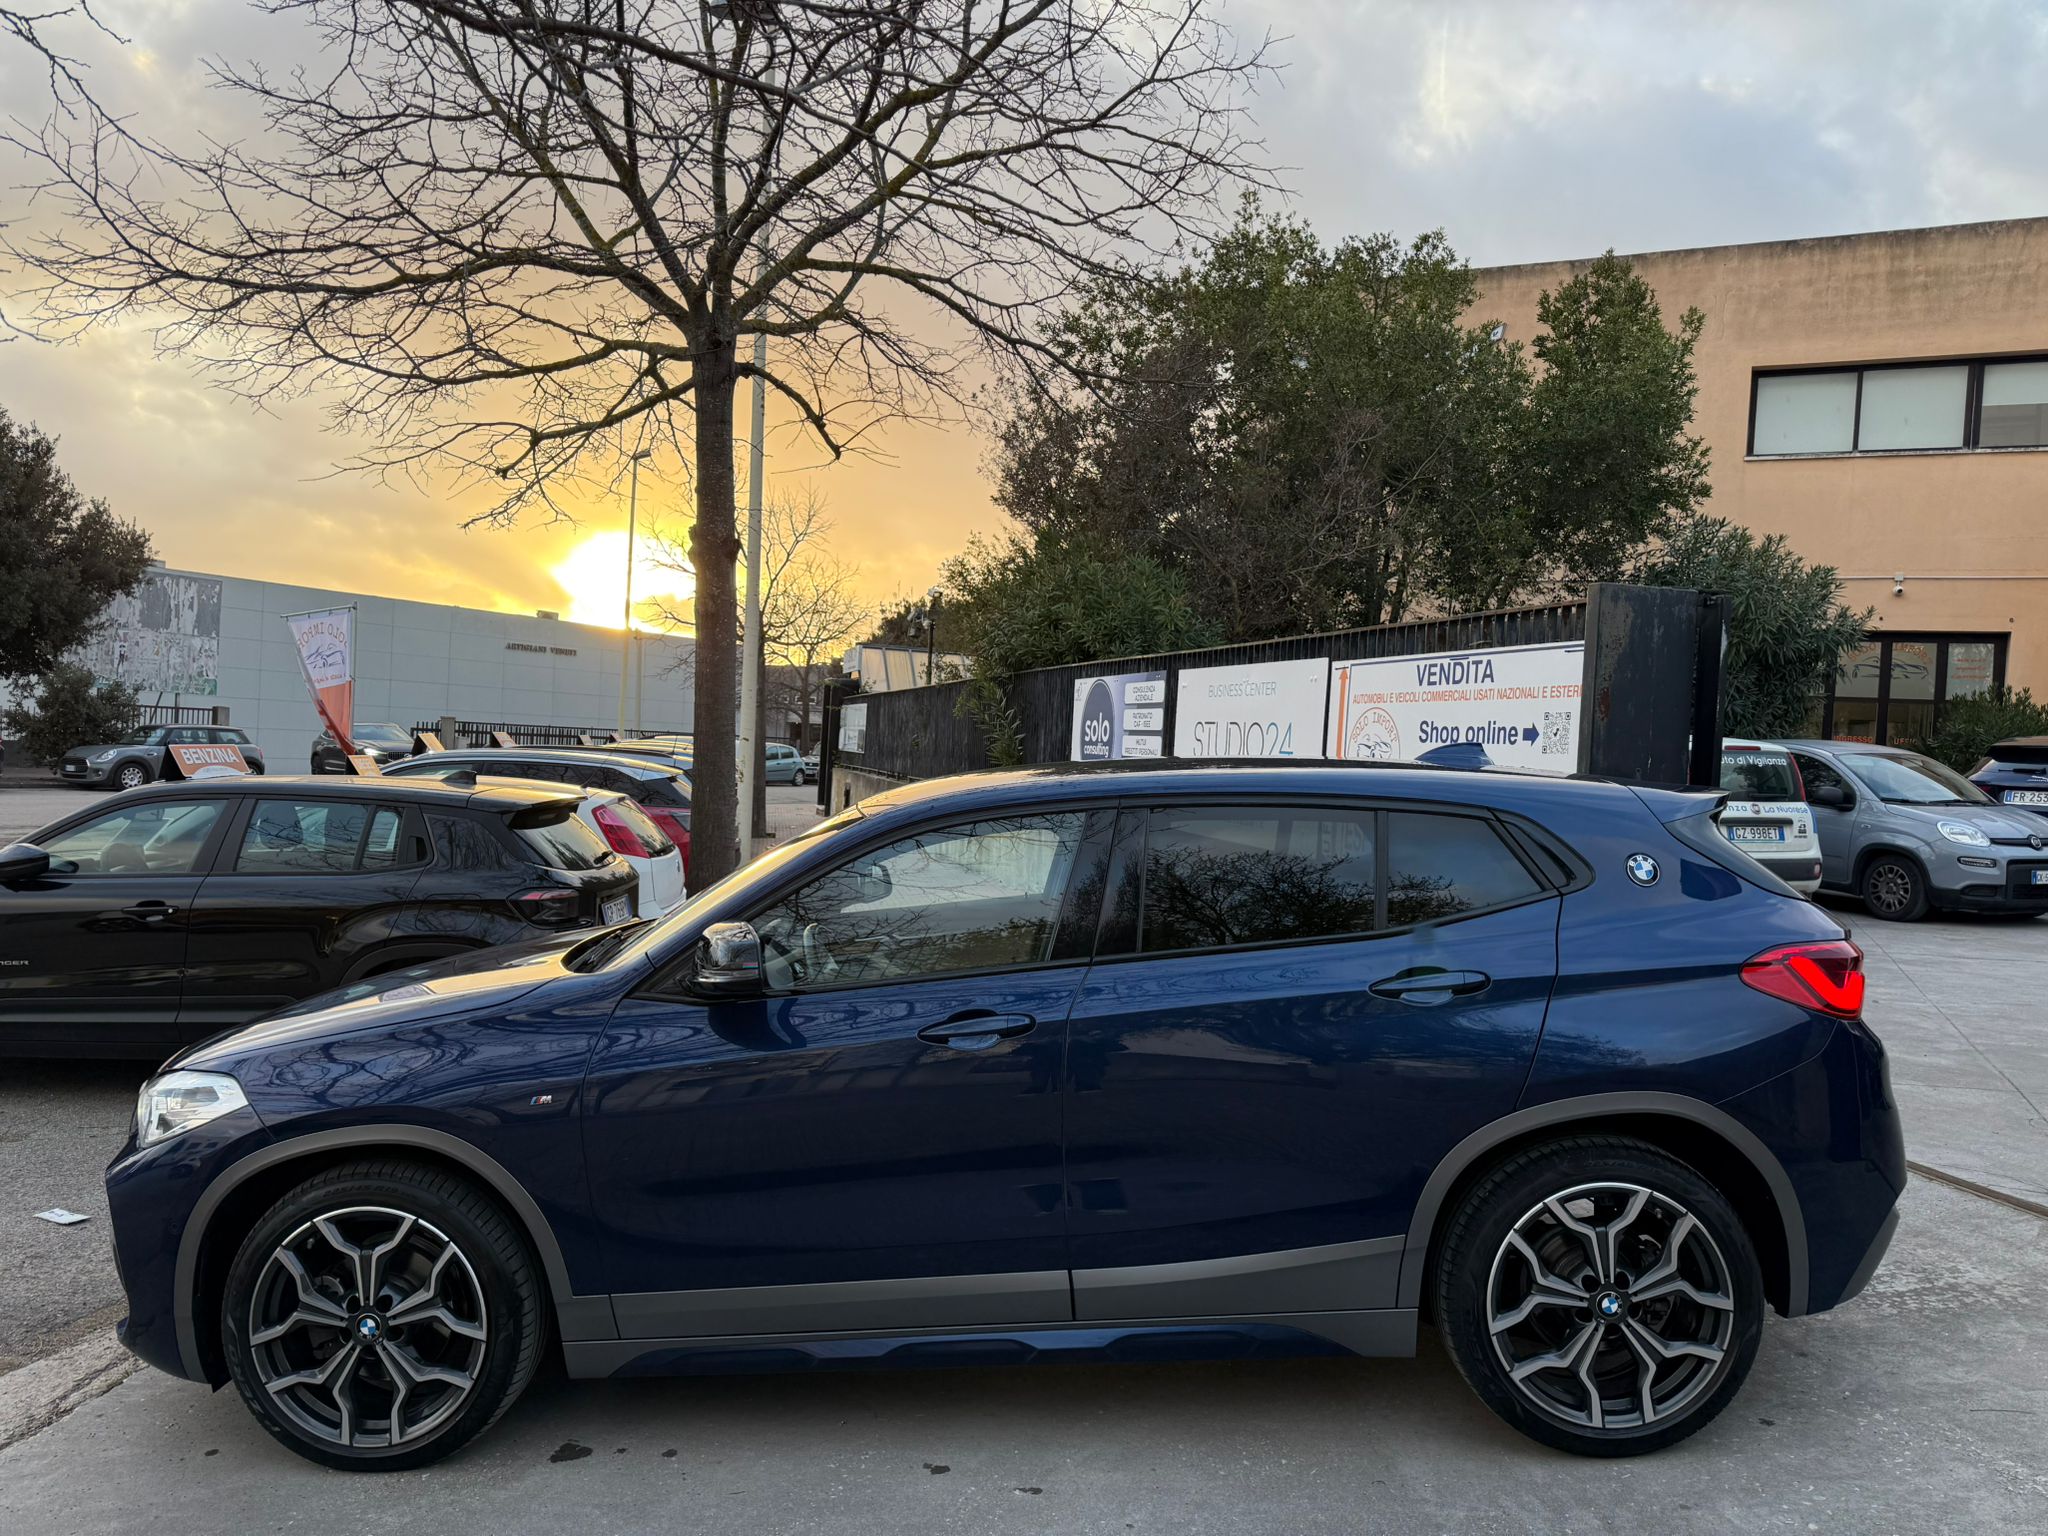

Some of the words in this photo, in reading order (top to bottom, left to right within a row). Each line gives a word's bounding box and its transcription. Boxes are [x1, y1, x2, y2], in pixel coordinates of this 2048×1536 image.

[1417, 659, 1494, 687] VENDITA
[1208, 683, 1243, 698] BUSINESS
[1245, 681, 1277, 697] CENTER
[1353, 692, 1388, 704] AUTOMOBILI
[1389, 691, 1394, 703] E
[1395, 691, 1421, 703] VEICOLI
[1422, 689, 1472, 702] COMMERCIALI
[1474, 688, 1495, 701] USATI
[1497, 686, 1540, 700] NAZIONALI
[1542, 686, 1548, 699] E
[1084, 712, 1110, 742] solo
[1353, 715, 1369, 744] SOLO
[1419, 720, 1460, 744] Shop
[1465, 720, 1518, 745] online
[180, 748, 240, 765] BENZINA
[1083, 744, 1109, 758] consulting
[1736, 756, 1746, 764] di
[1746, 755, 1786, 768] Vigilanza
